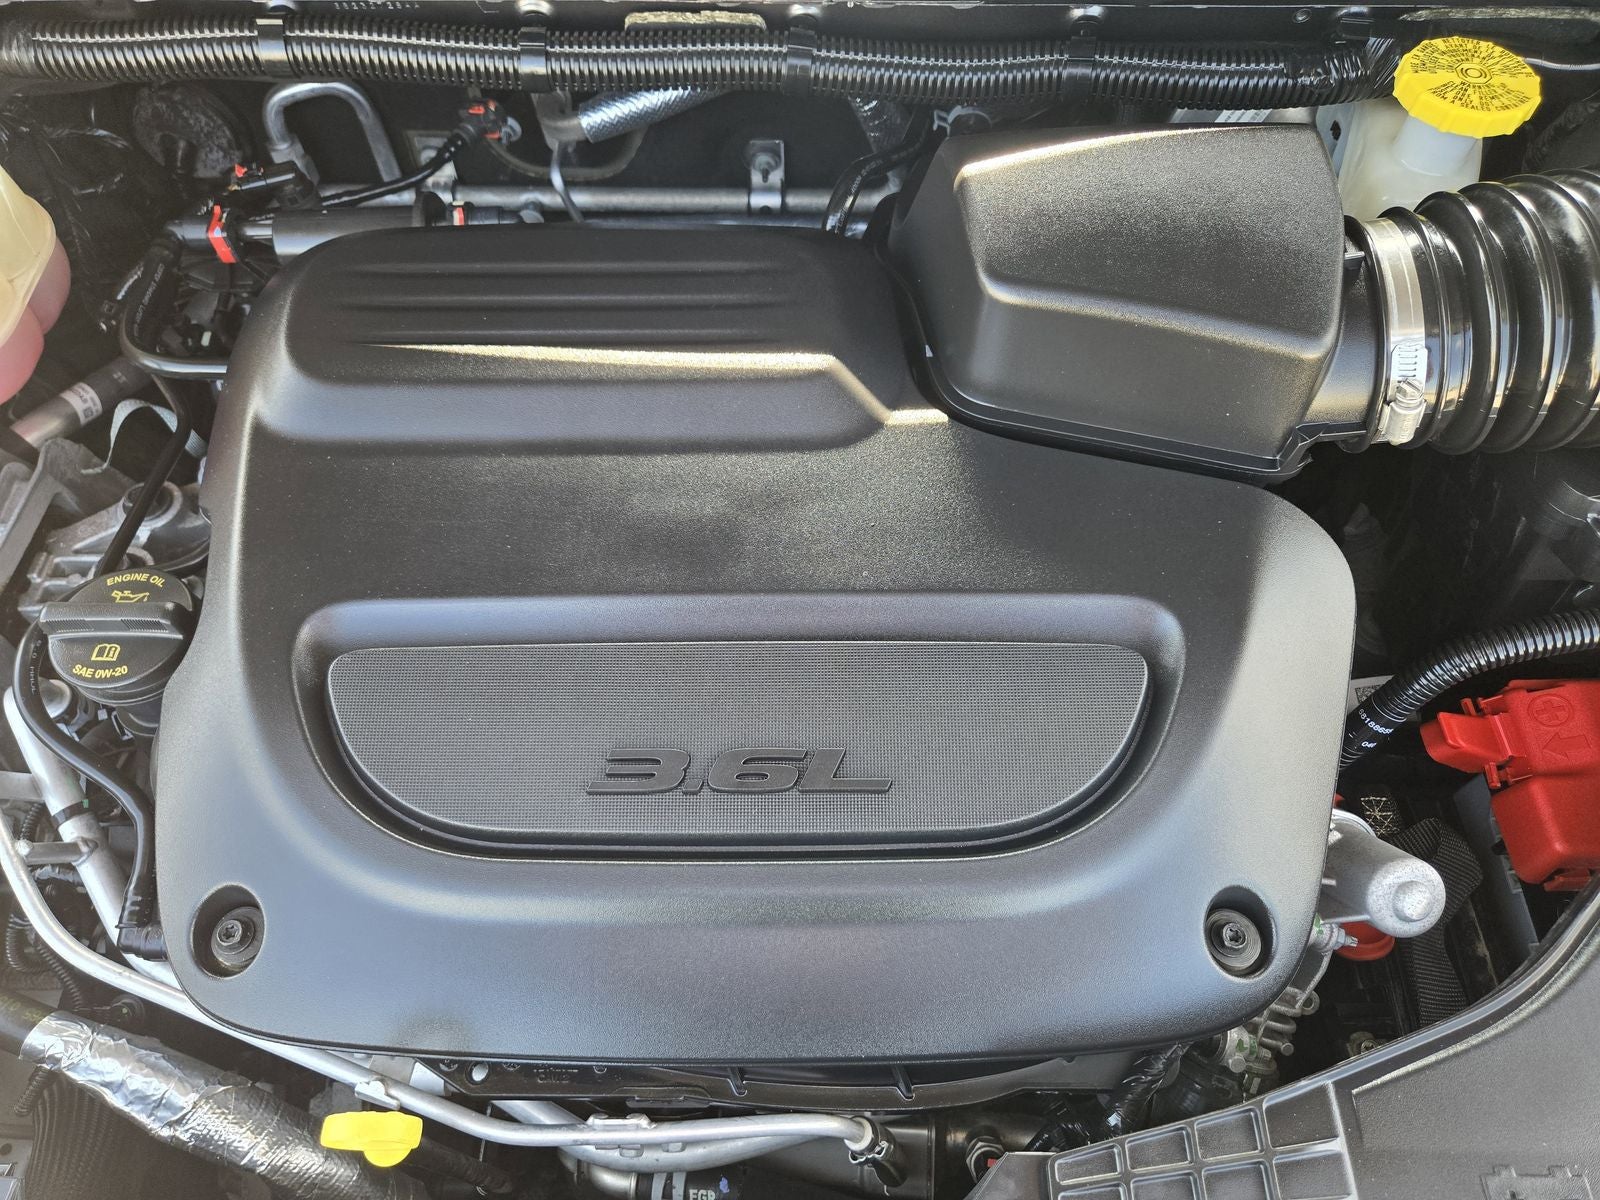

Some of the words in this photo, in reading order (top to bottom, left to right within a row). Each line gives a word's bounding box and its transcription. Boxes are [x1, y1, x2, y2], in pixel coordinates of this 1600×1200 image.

[106, 573, 149, 586] ENGINE
[150, 575, 166, 588] OIL
[73, 664, 95, 678] SAE
[95, 665, 128, 679] 0W-20
[587, 748, 892, 795] 3.6L
